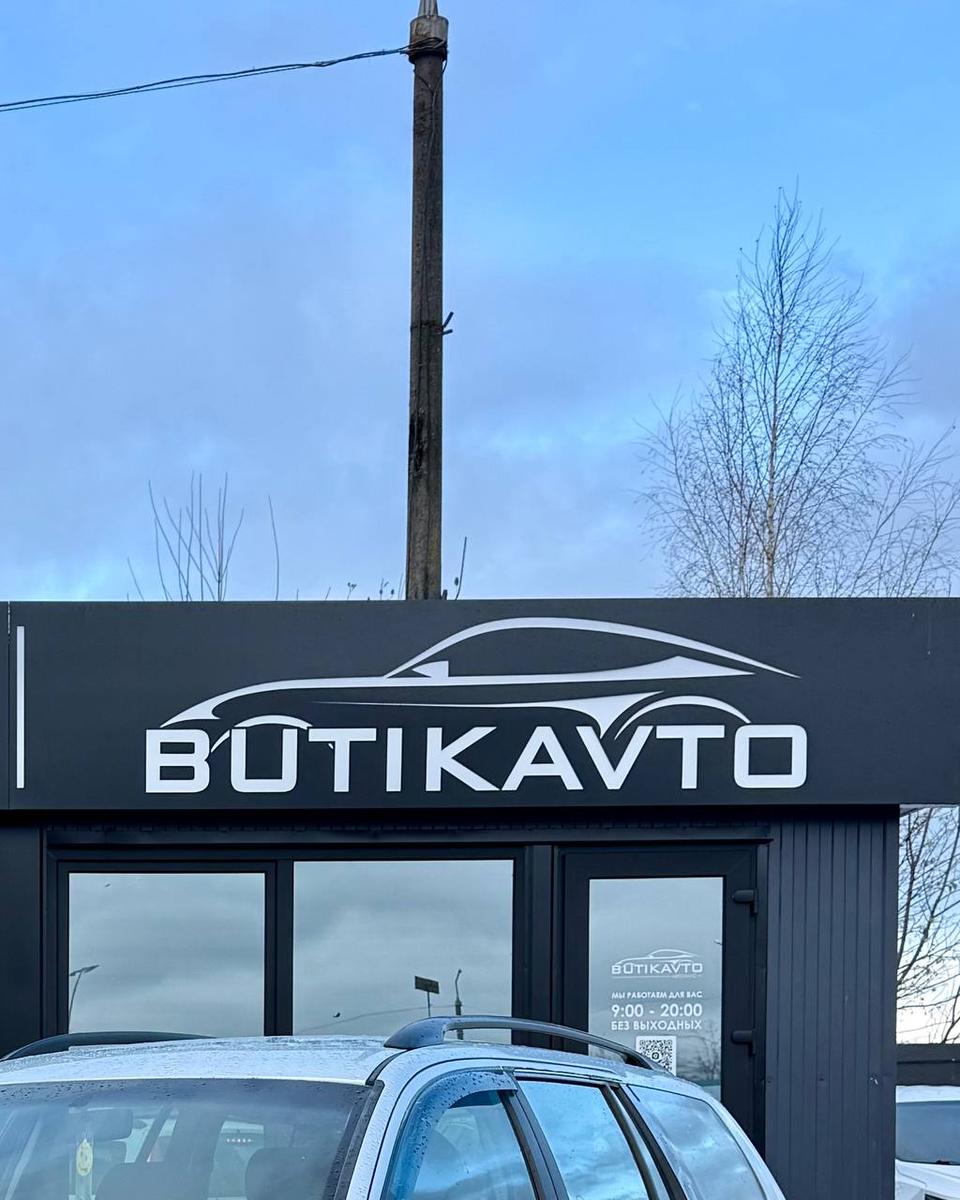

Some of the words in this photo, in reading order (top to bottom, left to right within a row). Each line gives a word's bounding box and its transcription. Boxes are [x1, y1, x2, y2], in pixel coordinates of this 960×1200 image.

[145, 723, 807, 793] BUTIKAVTO
[611, 962, 703, 975] BUTIKAVTO
[611, 991, 625, 999] МЫ
[686, 990, 703, 999] ВАС
[611, 1003, 644, 1018] 9:00
[660, 1003, 703, 1017] 20:00
[611, 1020, 630, 1031] БЕЗ
[633, 1020, 703, 1031] ВЫХОДНЫХ
